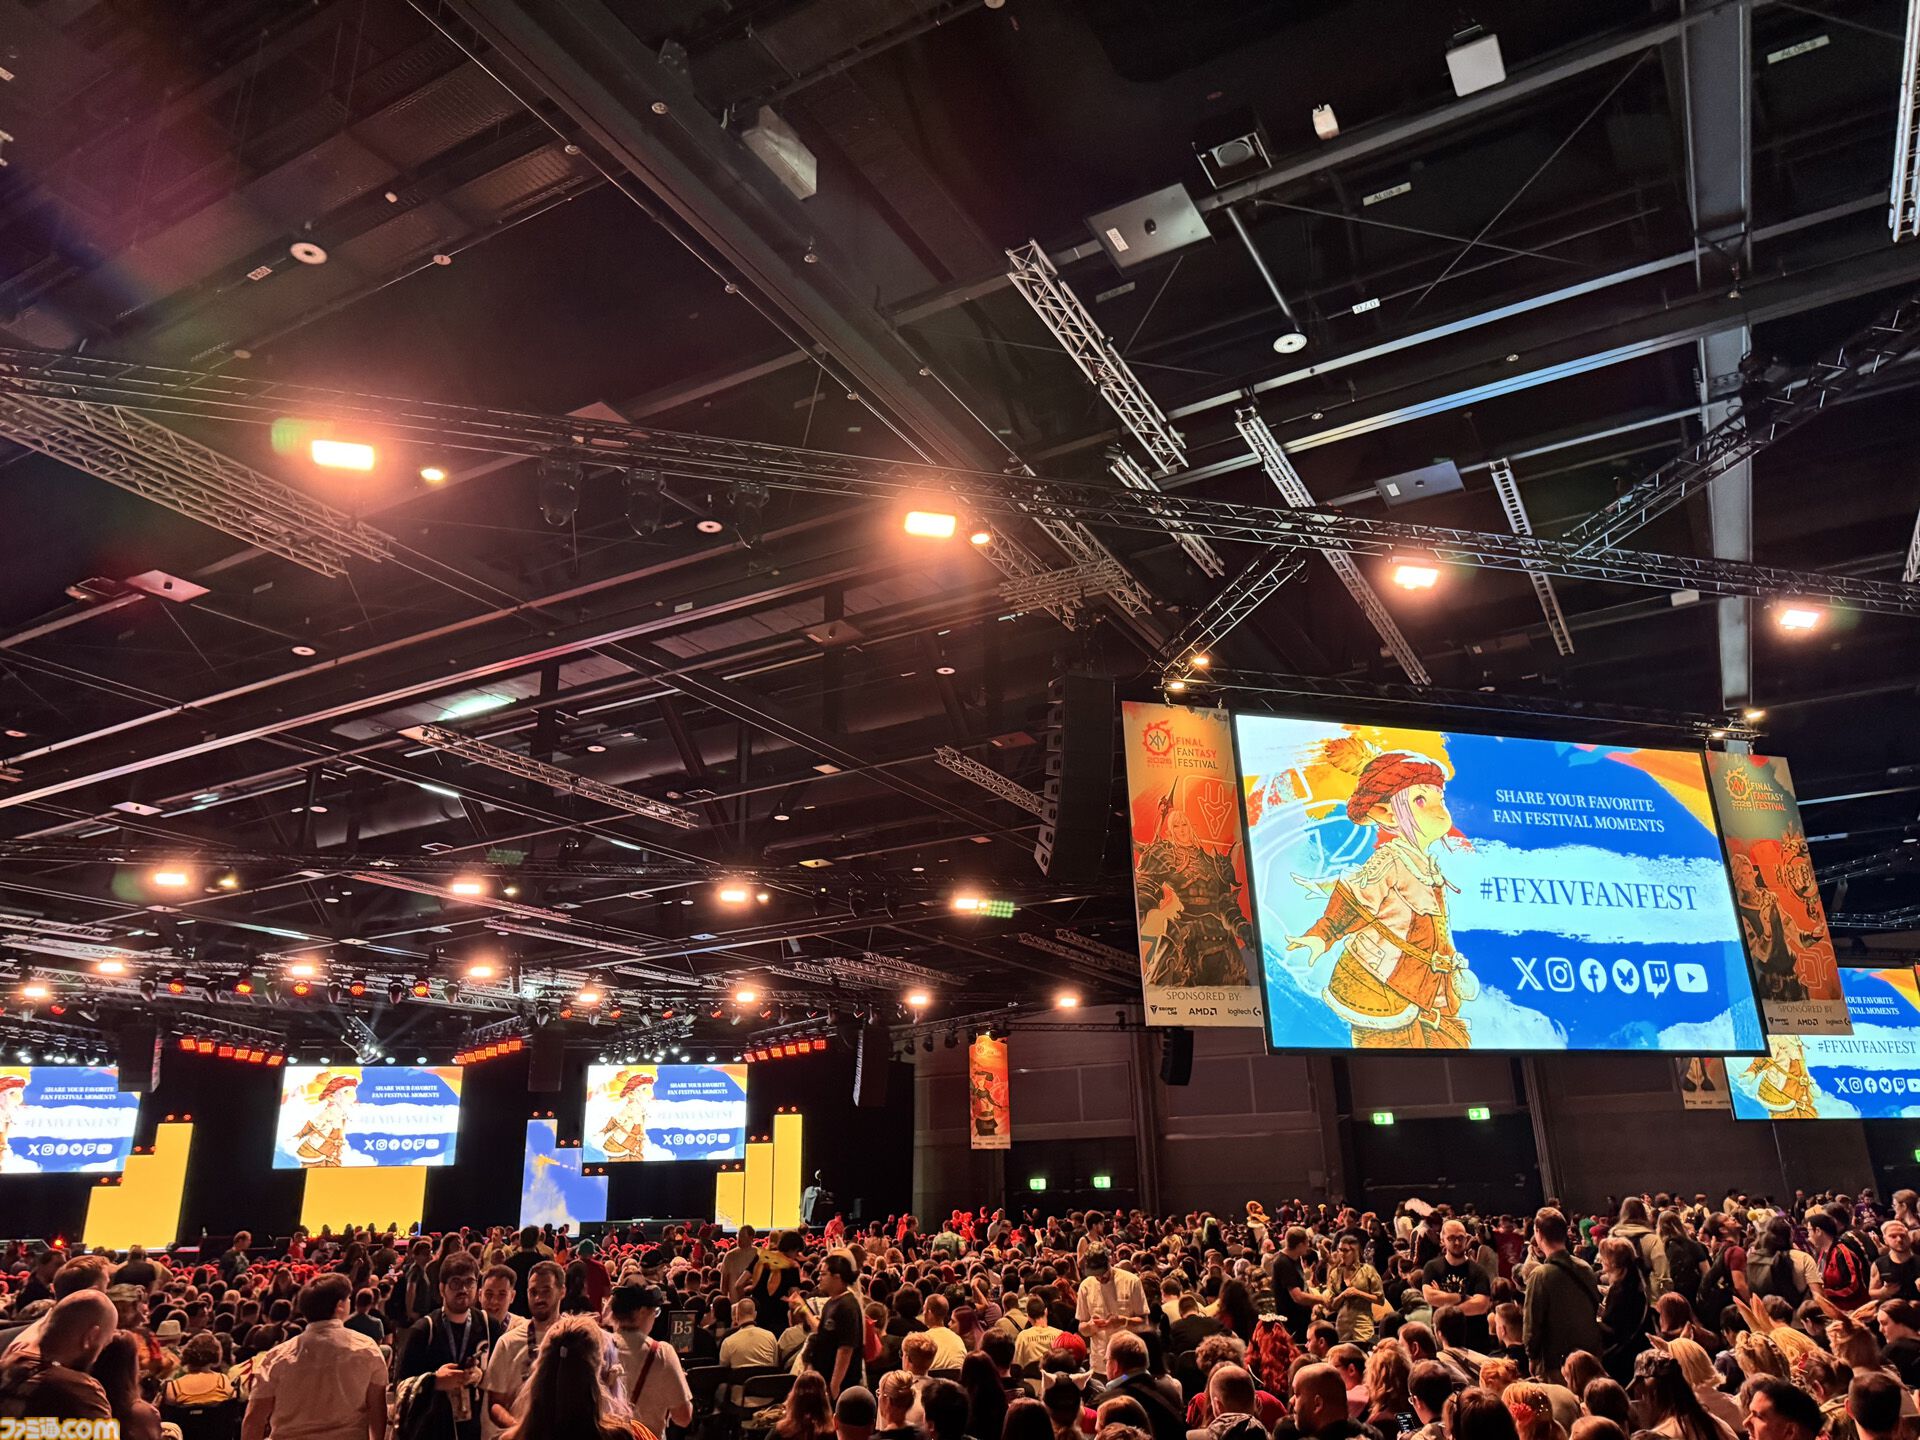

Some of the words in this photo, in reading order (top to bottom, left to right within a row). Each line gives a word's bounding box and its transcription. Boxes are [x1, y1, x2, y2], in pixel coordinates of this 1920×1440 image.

[1176, 737, 1204, 747] FINAL
[1177, 747, 1217, 758] FANTASY
[1178, 759, 1218, 770] FESTIVAL
[1750, 782, 1773, 792] FINAL
[1496, 789, 1546, 805] SHARE
[1547, 793, 1587, 808] YOUR
[1588, 796, 1656, 812] FAVORITE
[1753, 791, 1784, 801] FANTASY
[1755, 801, 1787, 811] FESTIVAL
[1492, 809, 1523, 824] FAN
[1524, 811, 1593, 829] FESTIVAL
[1594, 816, 1665, 833] MOMENTS
[1480, 876, 1698, 911] #FFXIVFANFEST
[1166, 991, 1226, 1000] SPONSORED
[1846, 996, 1862, 1004] OUR
[1862, 996, 1895, 1005] FAVORITE
[1189, 1007, 1211, 1016] AMD
[1228, 1008, 1252, 1017] logitech
[1778, 1004, 1823, 1014] SPONSORED
[1866, 1007, 1900, 1015] MOMENTS
[1818, 1040, 1917, 1054] #FFXIVFANFEST
[673, 1320, 693, 1335] B5
